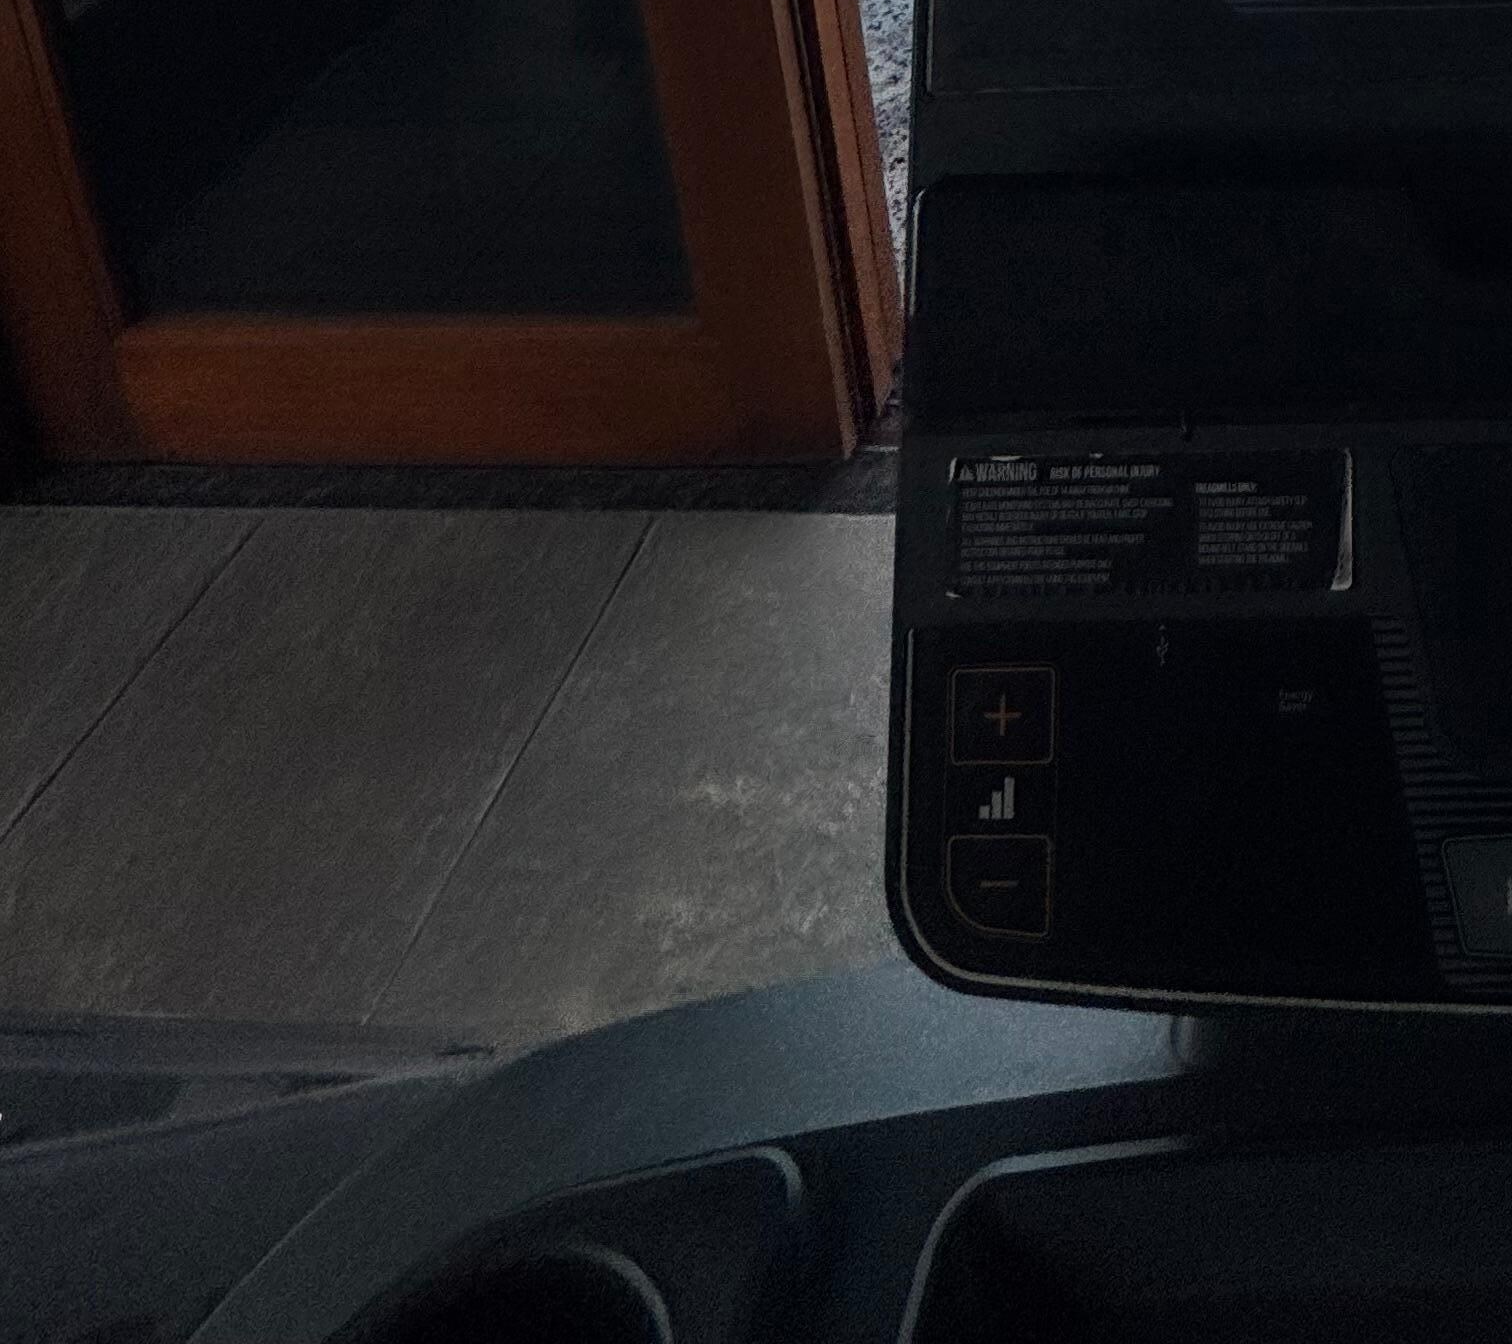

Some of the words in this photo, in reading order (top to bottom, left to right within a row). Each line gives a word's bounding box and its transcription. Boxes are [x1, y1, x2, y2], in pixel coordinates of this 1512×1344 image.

[975, 463, 1038, 482] WARNING
[1050, 465, 1070, 481] RISK
[1071, 465, 1083, 481] OF
[1083, 464, 1129, 479] PERSONAL
[1130, 464, 1160, 479] INJURY
